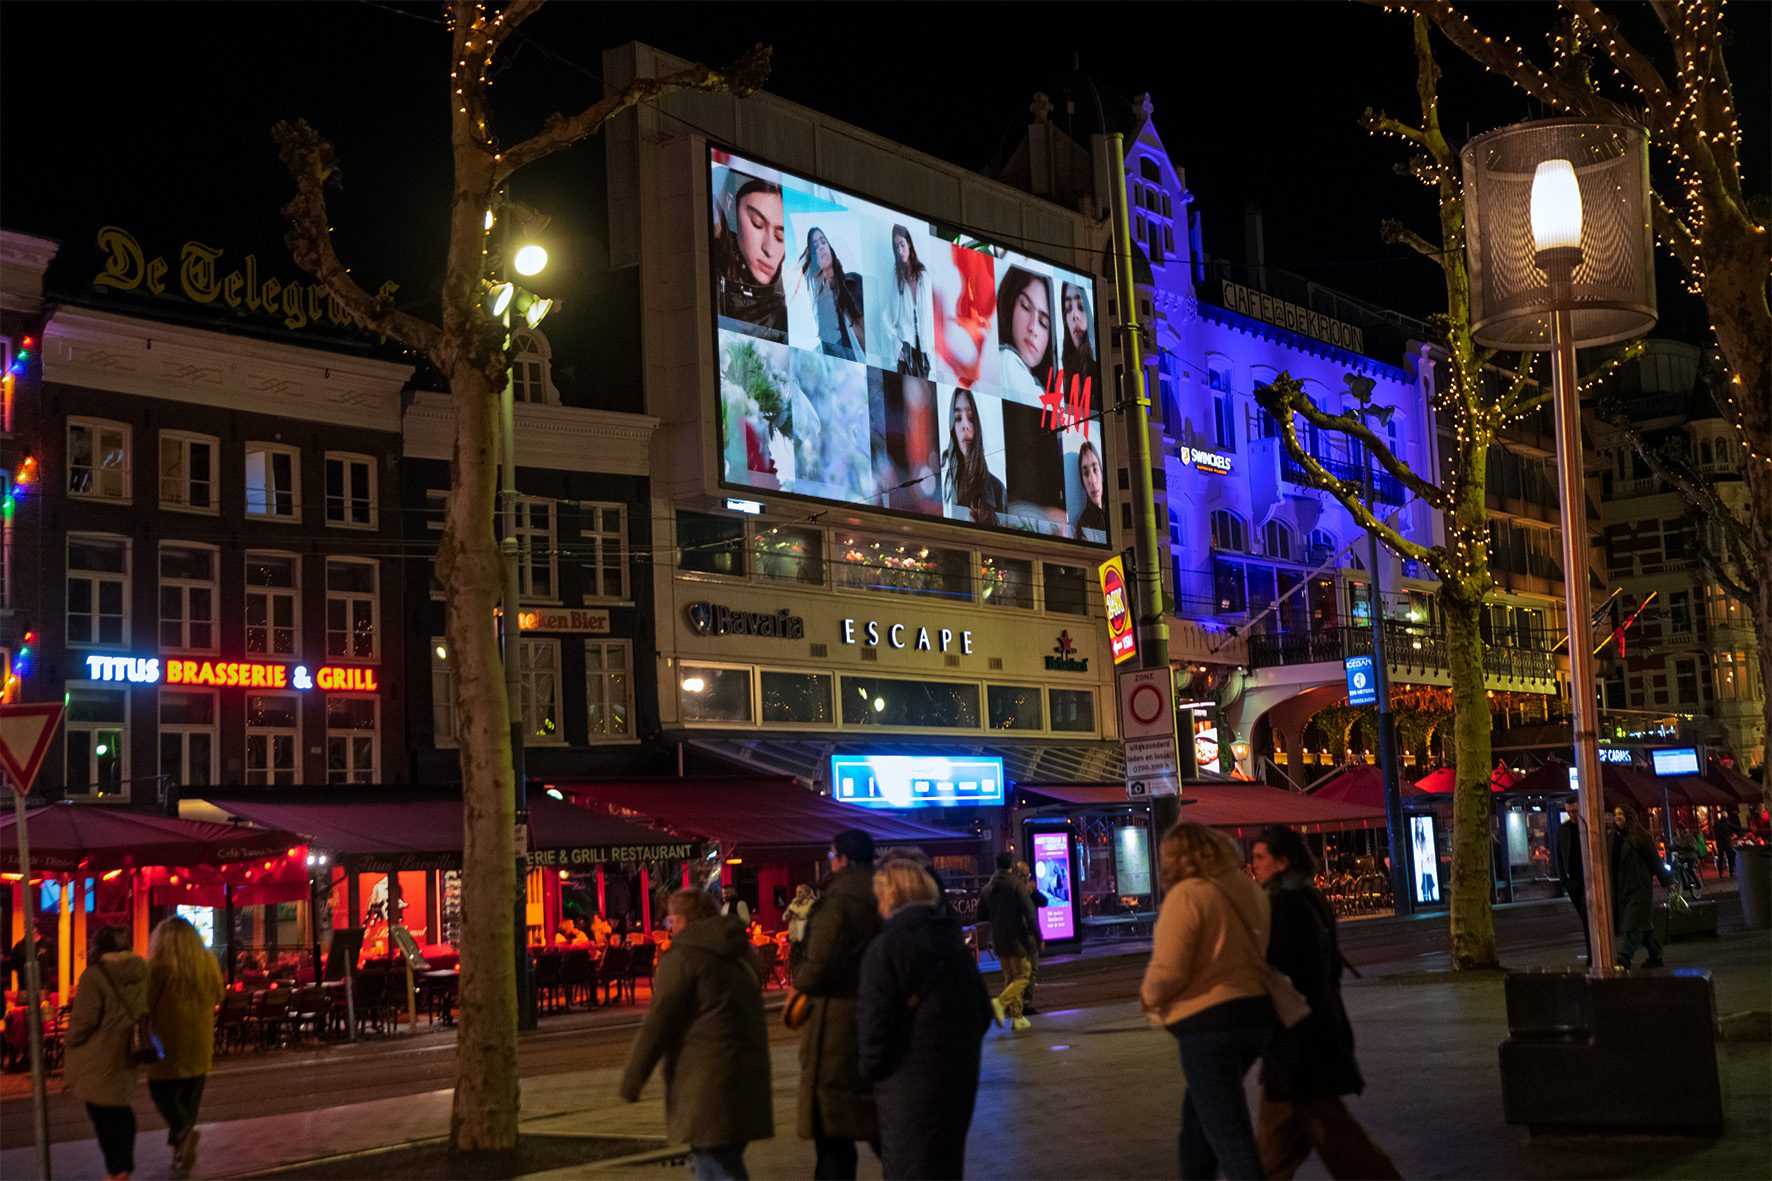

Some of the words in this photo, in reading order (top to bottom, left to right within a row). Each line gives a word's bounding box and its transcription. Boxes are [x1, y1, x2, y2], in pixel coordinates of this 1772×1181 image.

[94, 225, 168, 295] De
[1309, 311, 1363, 353] KROON
[1039, 366, 1092, 442] H&M
[570, 611, 607, 629] Bier
[716, 604, 804, 638] Bavaria
[842, 618, 973, 654] ESCAPE
[86, 656, 159, 683] TITUS
[167, 660, 286, 688] BRASSERIE
[292, 665, 313, 689] &
[316, 667, 377, 691] GRILL
[1134, 672, 1154, 682] ZONE
[559, 849, 569, 864] &
[571, 847, 609, 864] GRILL
[611, 844, 693, 862] RESTAURANT
